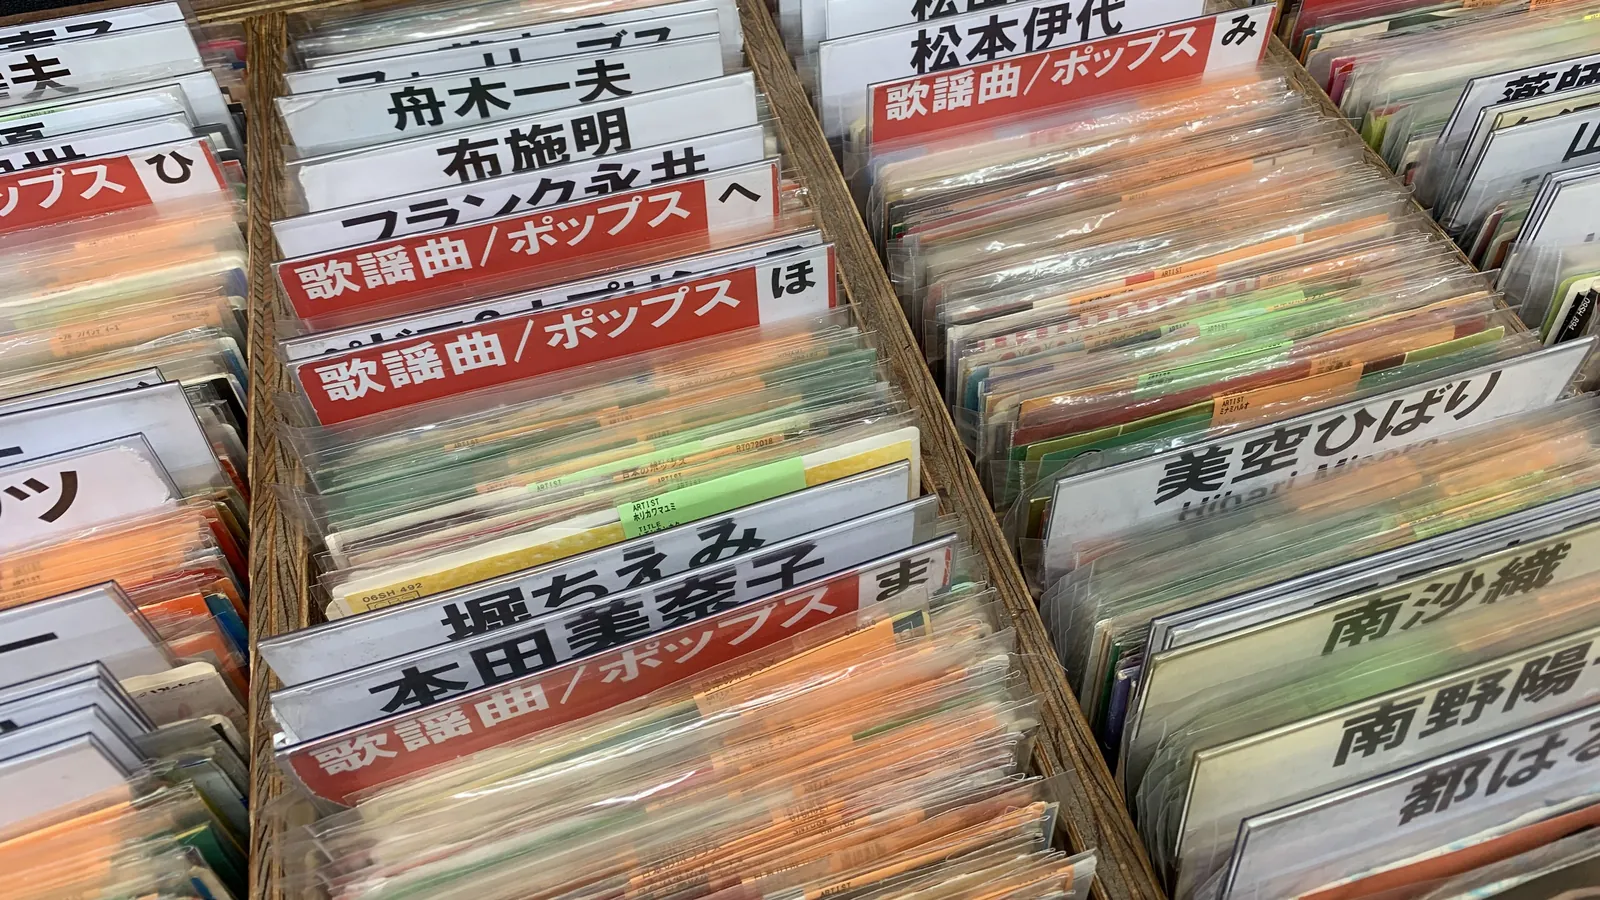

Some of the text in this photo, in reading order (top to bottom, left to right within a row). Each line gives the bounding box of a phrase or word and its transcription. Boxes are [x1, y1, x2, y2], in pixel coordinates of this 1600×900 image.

[885, 14, 1257, 121] 歌謡曲/ポップス み
[910, 0, 1126, 75] 松本伊代
[387, 59, 633, 131] 舟木一夫
[437, 107, 632, 182] 布施明
[145, 150, 194, 184] ひ
[293, 182, 761, 300] 歌謡曲/ポップス へ
[314, 277, 742, 403] 歌謡曲/ポップス
[771, 260, 816, 298] ほ
[1154, 370, 1502, 505] 美空ひばり
[1221, 396, 1245, 407] ARTIST
[632, 498, 660, 512] ARTIST
[370, 541, 827, 713] 本田美奈子
[440, 522, 765, 641] 堀ちえみ
[1321, 542, 1572, 656] 南沙織
[308, 558, 932, 775] 歌謡曲/ポップス ま
[1333, 640, 1600, 768] 南野陽
